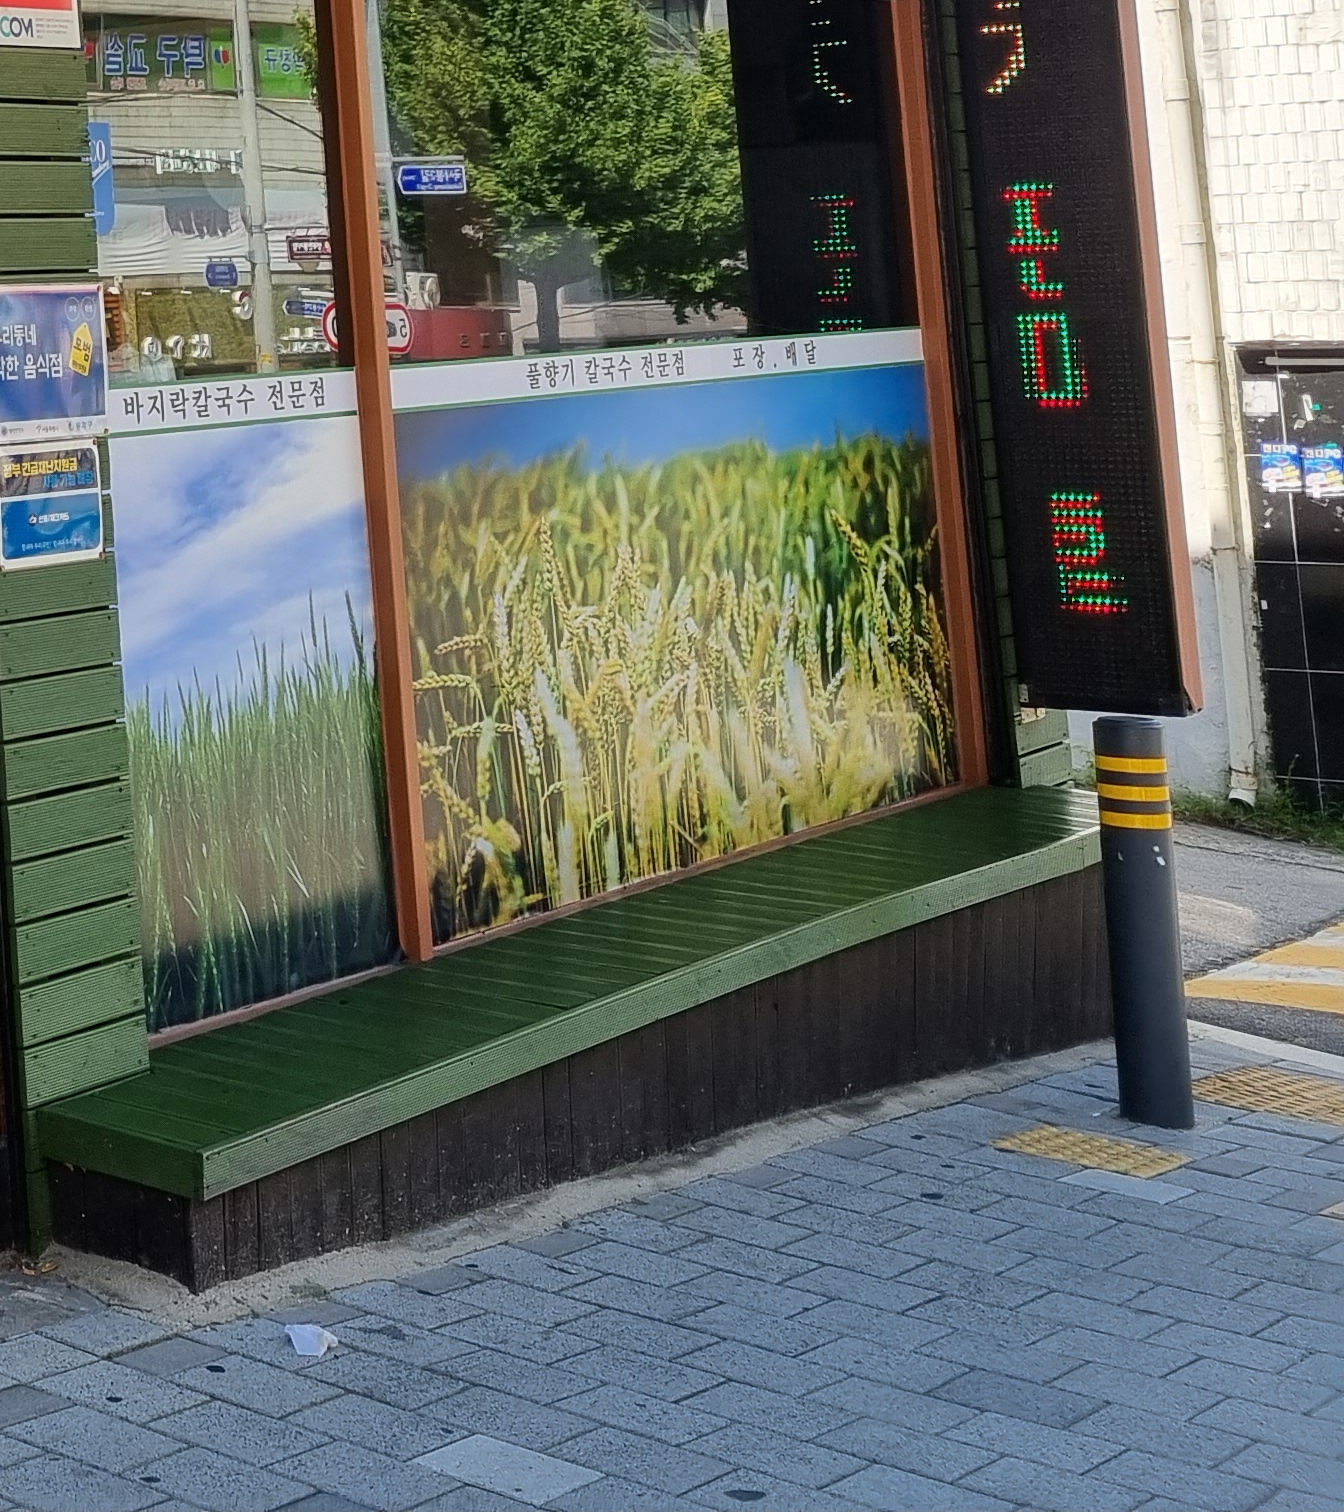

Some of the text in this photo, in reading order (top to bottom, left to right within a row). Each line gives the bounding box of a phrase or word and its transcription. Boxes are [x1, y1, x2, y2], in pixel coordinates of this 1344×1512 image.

[23, 353, 64, 379] 음식점
[73, 337, 91, 362] 모범
[525, 358, 577, 392] 풀향기
[582, 353, 634, 385] 칼국수
[640, 349, 686, 379] 전문점
[784, 340, 817, 366] 배달
[121, 374, 328, 426] 바지락칼국수 전문점
